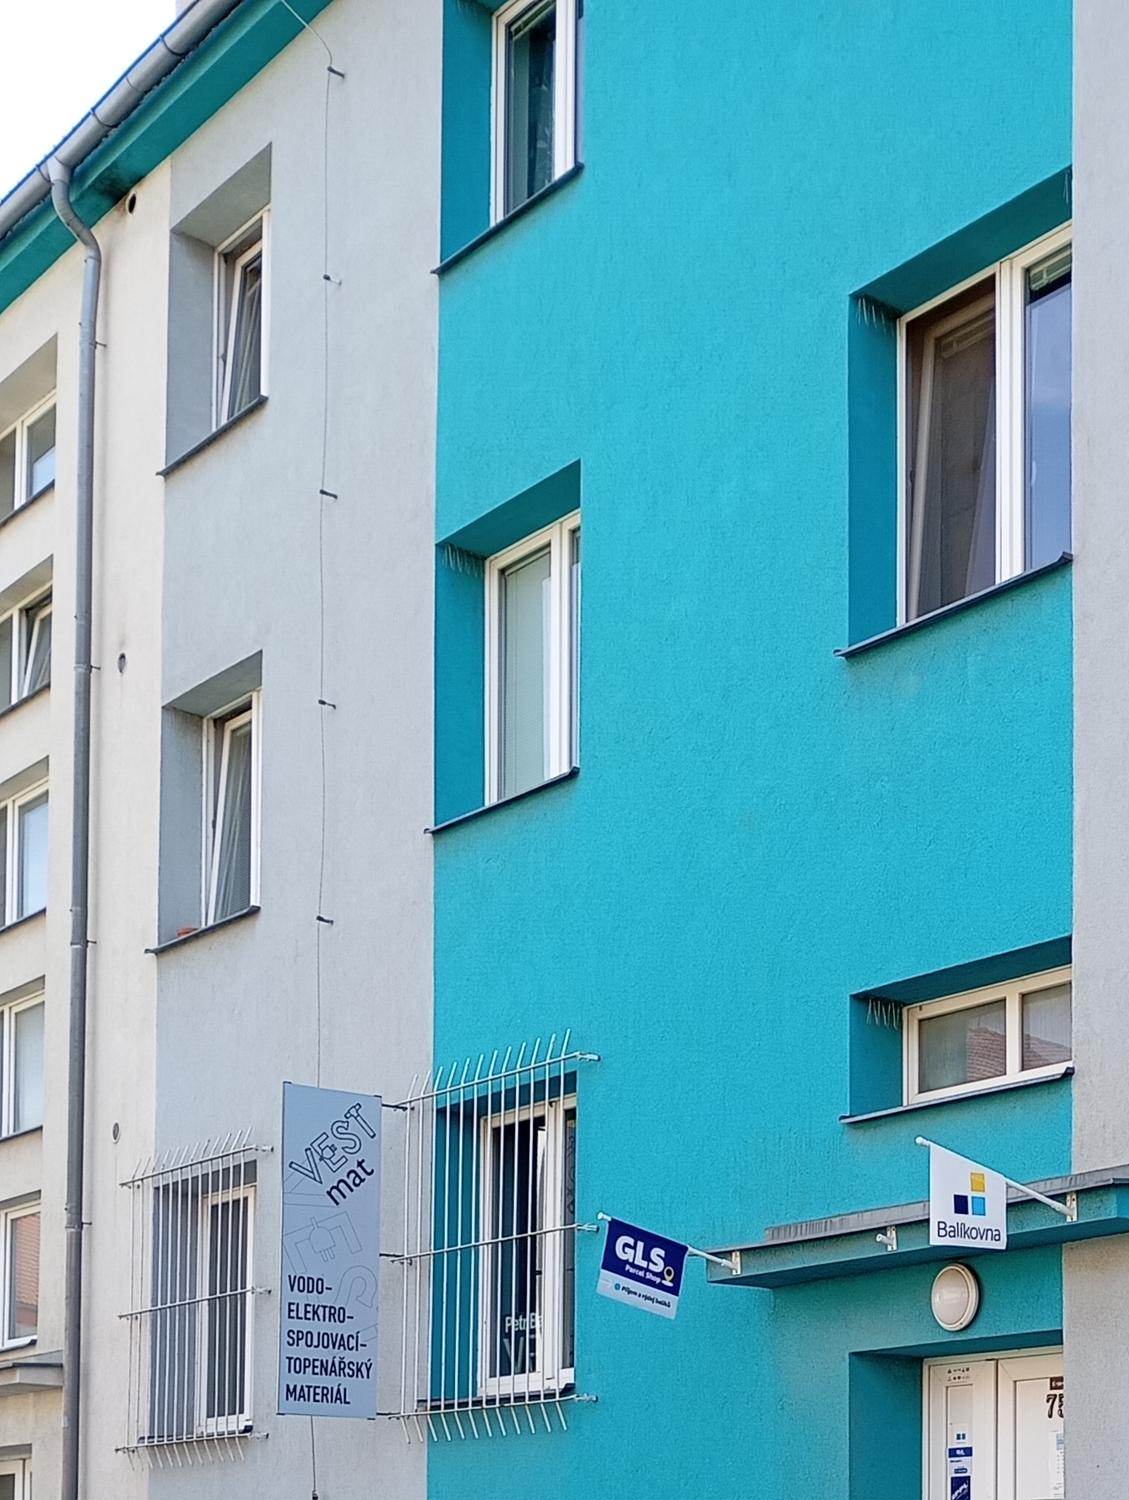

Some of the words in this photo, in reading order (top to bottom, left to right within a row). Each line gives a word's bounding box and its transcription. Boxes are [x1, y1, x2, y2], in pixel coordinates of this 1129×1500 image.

[288, 1103, 376, 1185] VEST
[325, 1158, 375, 1206] mat
[937, 1221, 1001, 1242] Balíkovna
[615, 1235, 665, 1273] GLS
[288, 1274, 332, 1295] VODO-
[287, 1302, 354, 1324] ELEKTRO-
[286, 1329, 367, 1352] SPOJOVACÍ-
[285, 1356, 373, 1380] TOPENÁŘSKÝ
[285, 1383, 350, 1405] MATERIÁL
